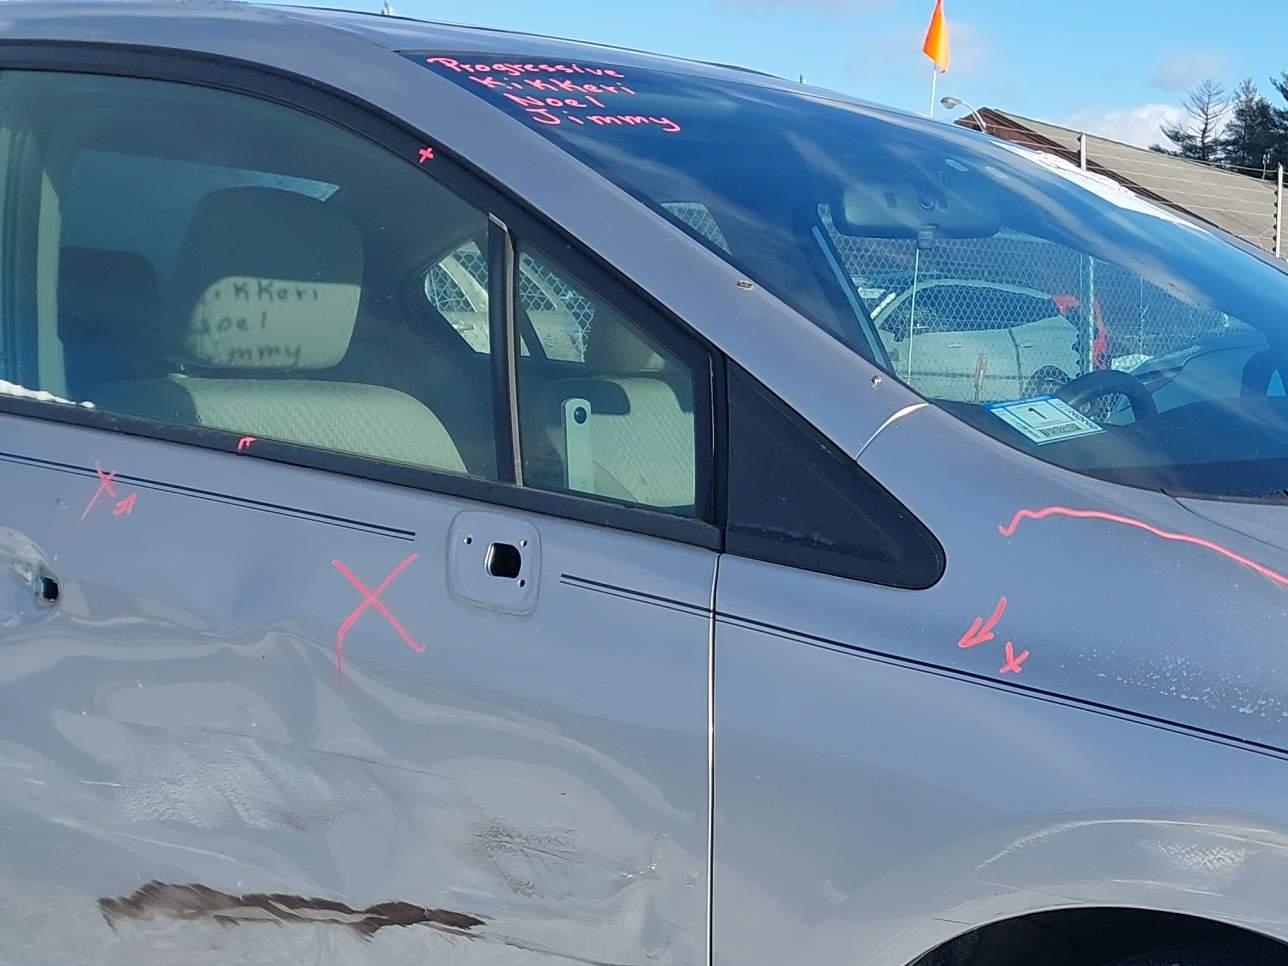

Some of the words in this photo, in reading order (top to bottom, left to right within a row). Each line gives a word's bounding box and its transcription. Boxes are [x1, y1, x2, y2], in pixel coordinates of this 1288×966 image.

[426, 57, 625, 78] Progressive
[502, 93, 606, 110] Noel
[525, 107, 682, 133] Jimmy
